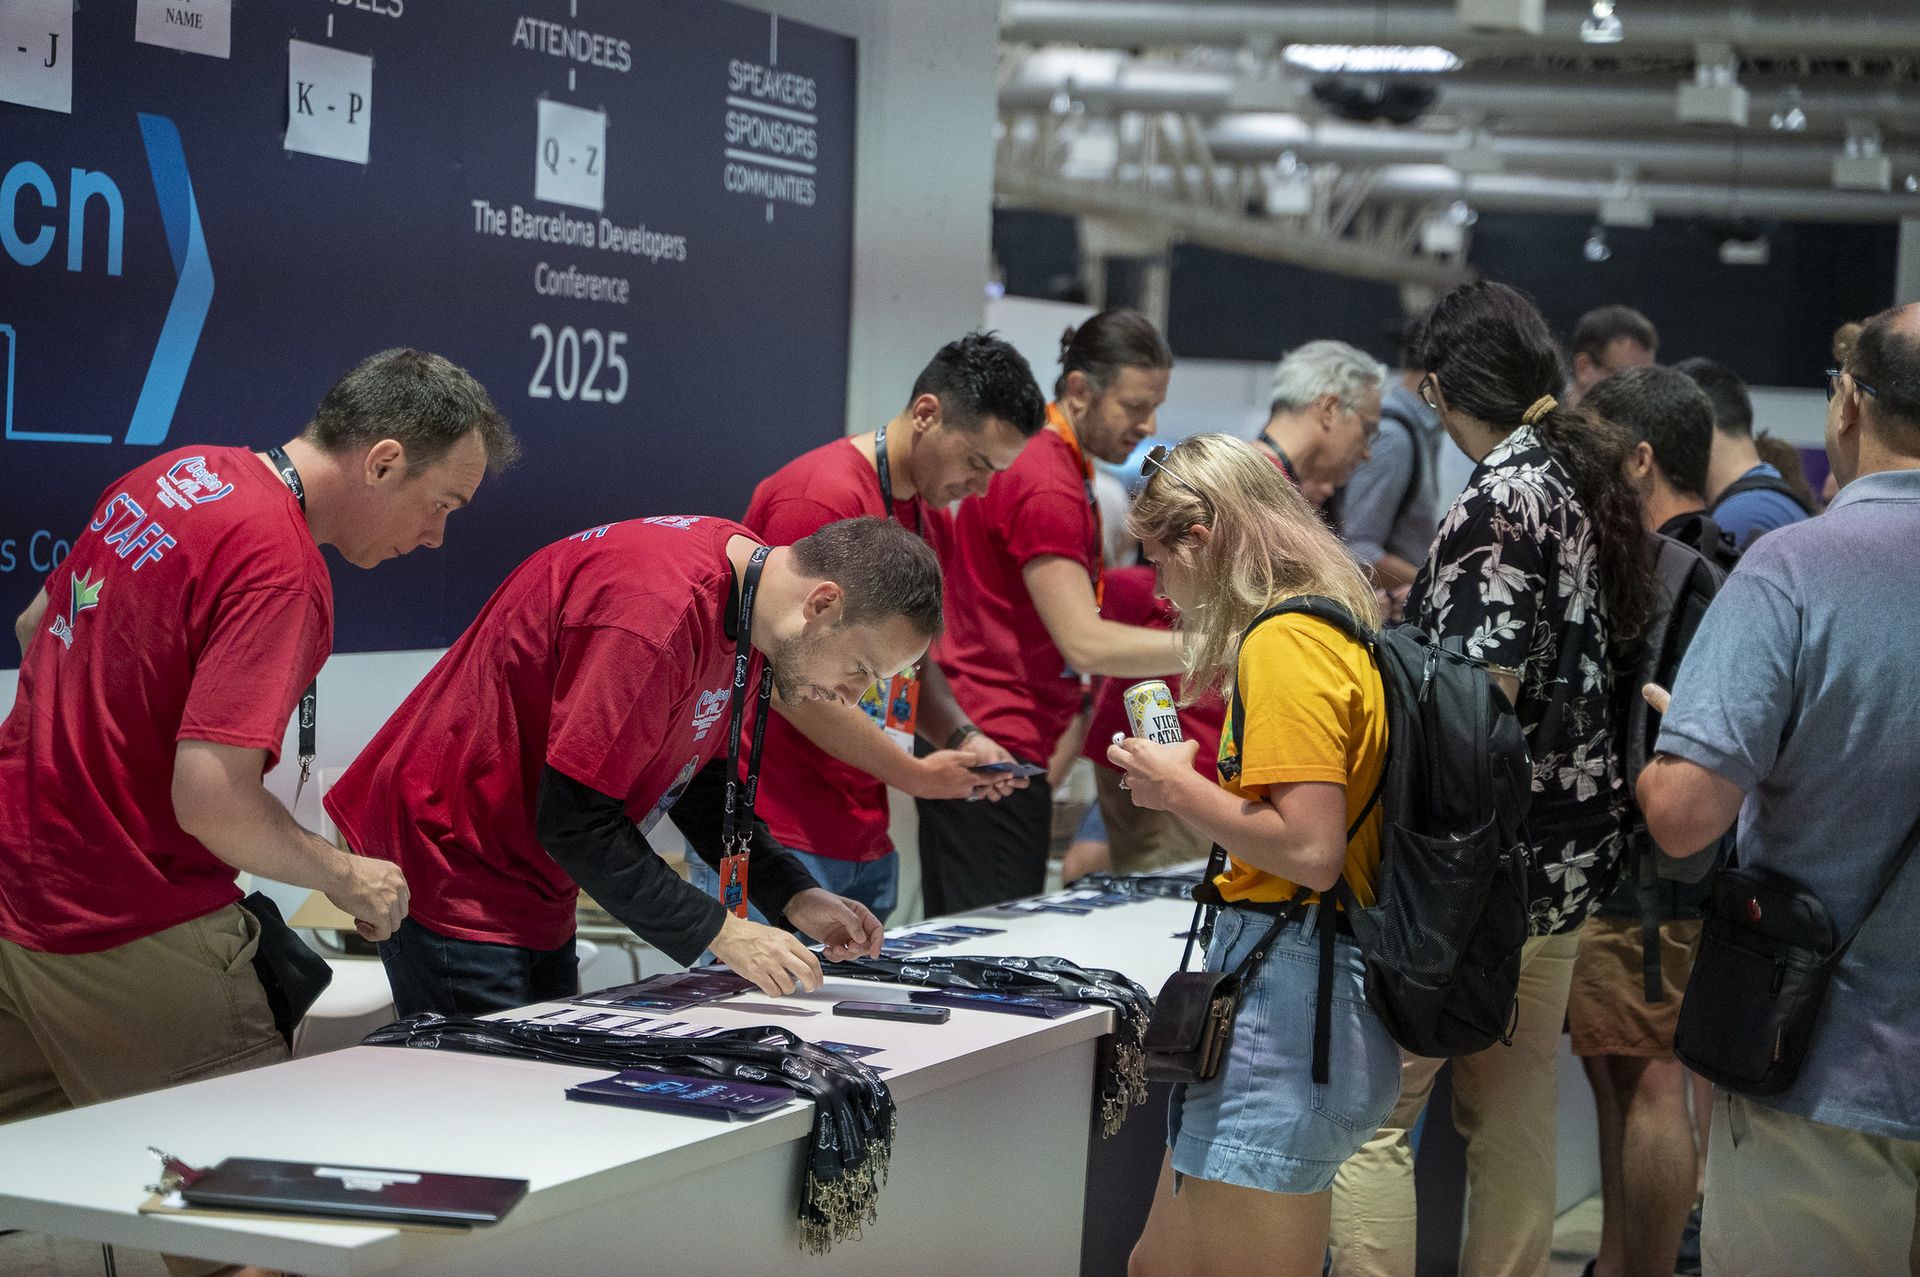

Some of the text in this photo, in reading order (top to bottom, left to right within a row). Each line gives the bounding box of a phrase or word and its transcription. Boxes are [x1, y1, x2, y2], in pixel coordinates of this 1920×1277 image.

[165, 8, 203, 30] NAME
[44, 33, 59, 68] J
[513, 16, 632, 72] ATTENDEES
[296, 82, 314, 117] K
[347, 92, 363, 125] P
[728, 58, 817, 109] SPEAKERS
[543, 136, 560, 175] Q
[586, 145, 599, 176] Z
[724, 110, 818, 160] SPONSORS
[723, 162, 817, 206] COMMUNITIES
[472, 199, 688, 264] The Barcelona Developers
[534, 261, 630, 305] Conference
[528, 323, 629, 405] 2025
[29, 529, 77, 573] Co
[90, 492, 178, 571] STAFF
